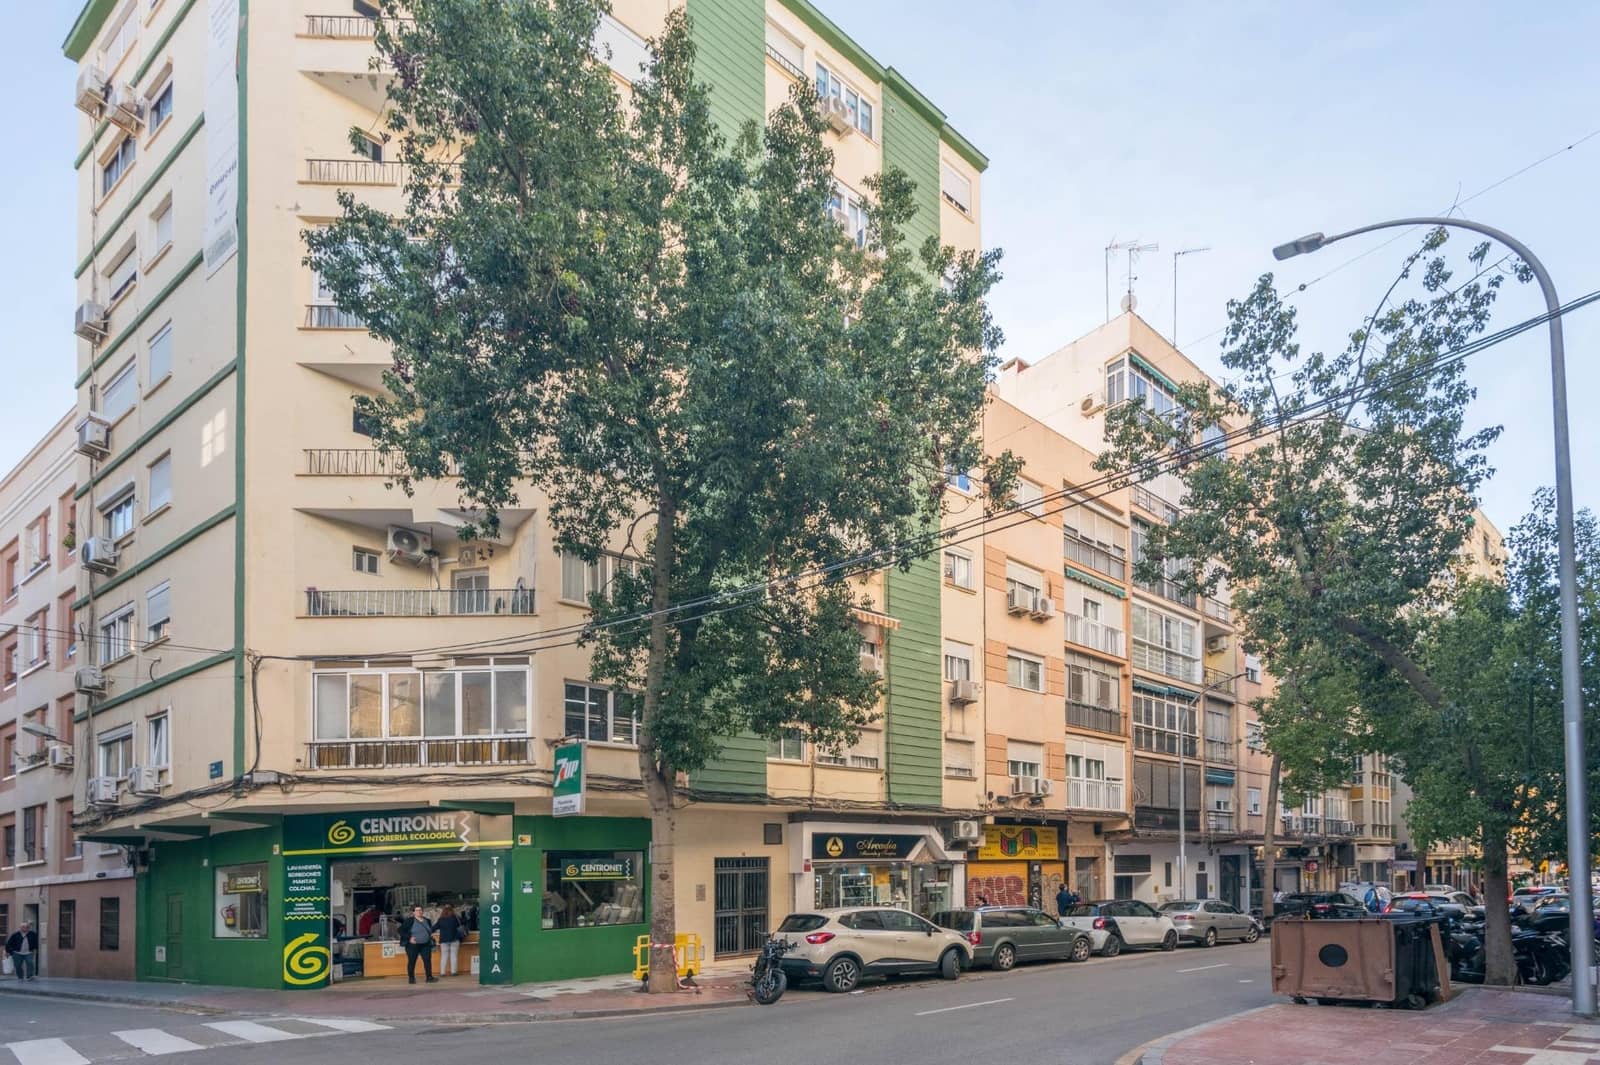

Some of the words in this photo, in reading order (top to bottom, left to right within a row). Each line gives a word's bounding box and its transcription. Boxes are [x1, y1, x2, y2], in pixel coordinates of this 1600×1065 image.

[360, 815, 457, 834] CENTRONET
[362, 833, 408, 843] TINTORERIA
[410, 831, 457, 841] ECOLOGICA
[581, 863, 623, 872] CENTRONET
[490, 856, 501, 974] TINTORERIA
